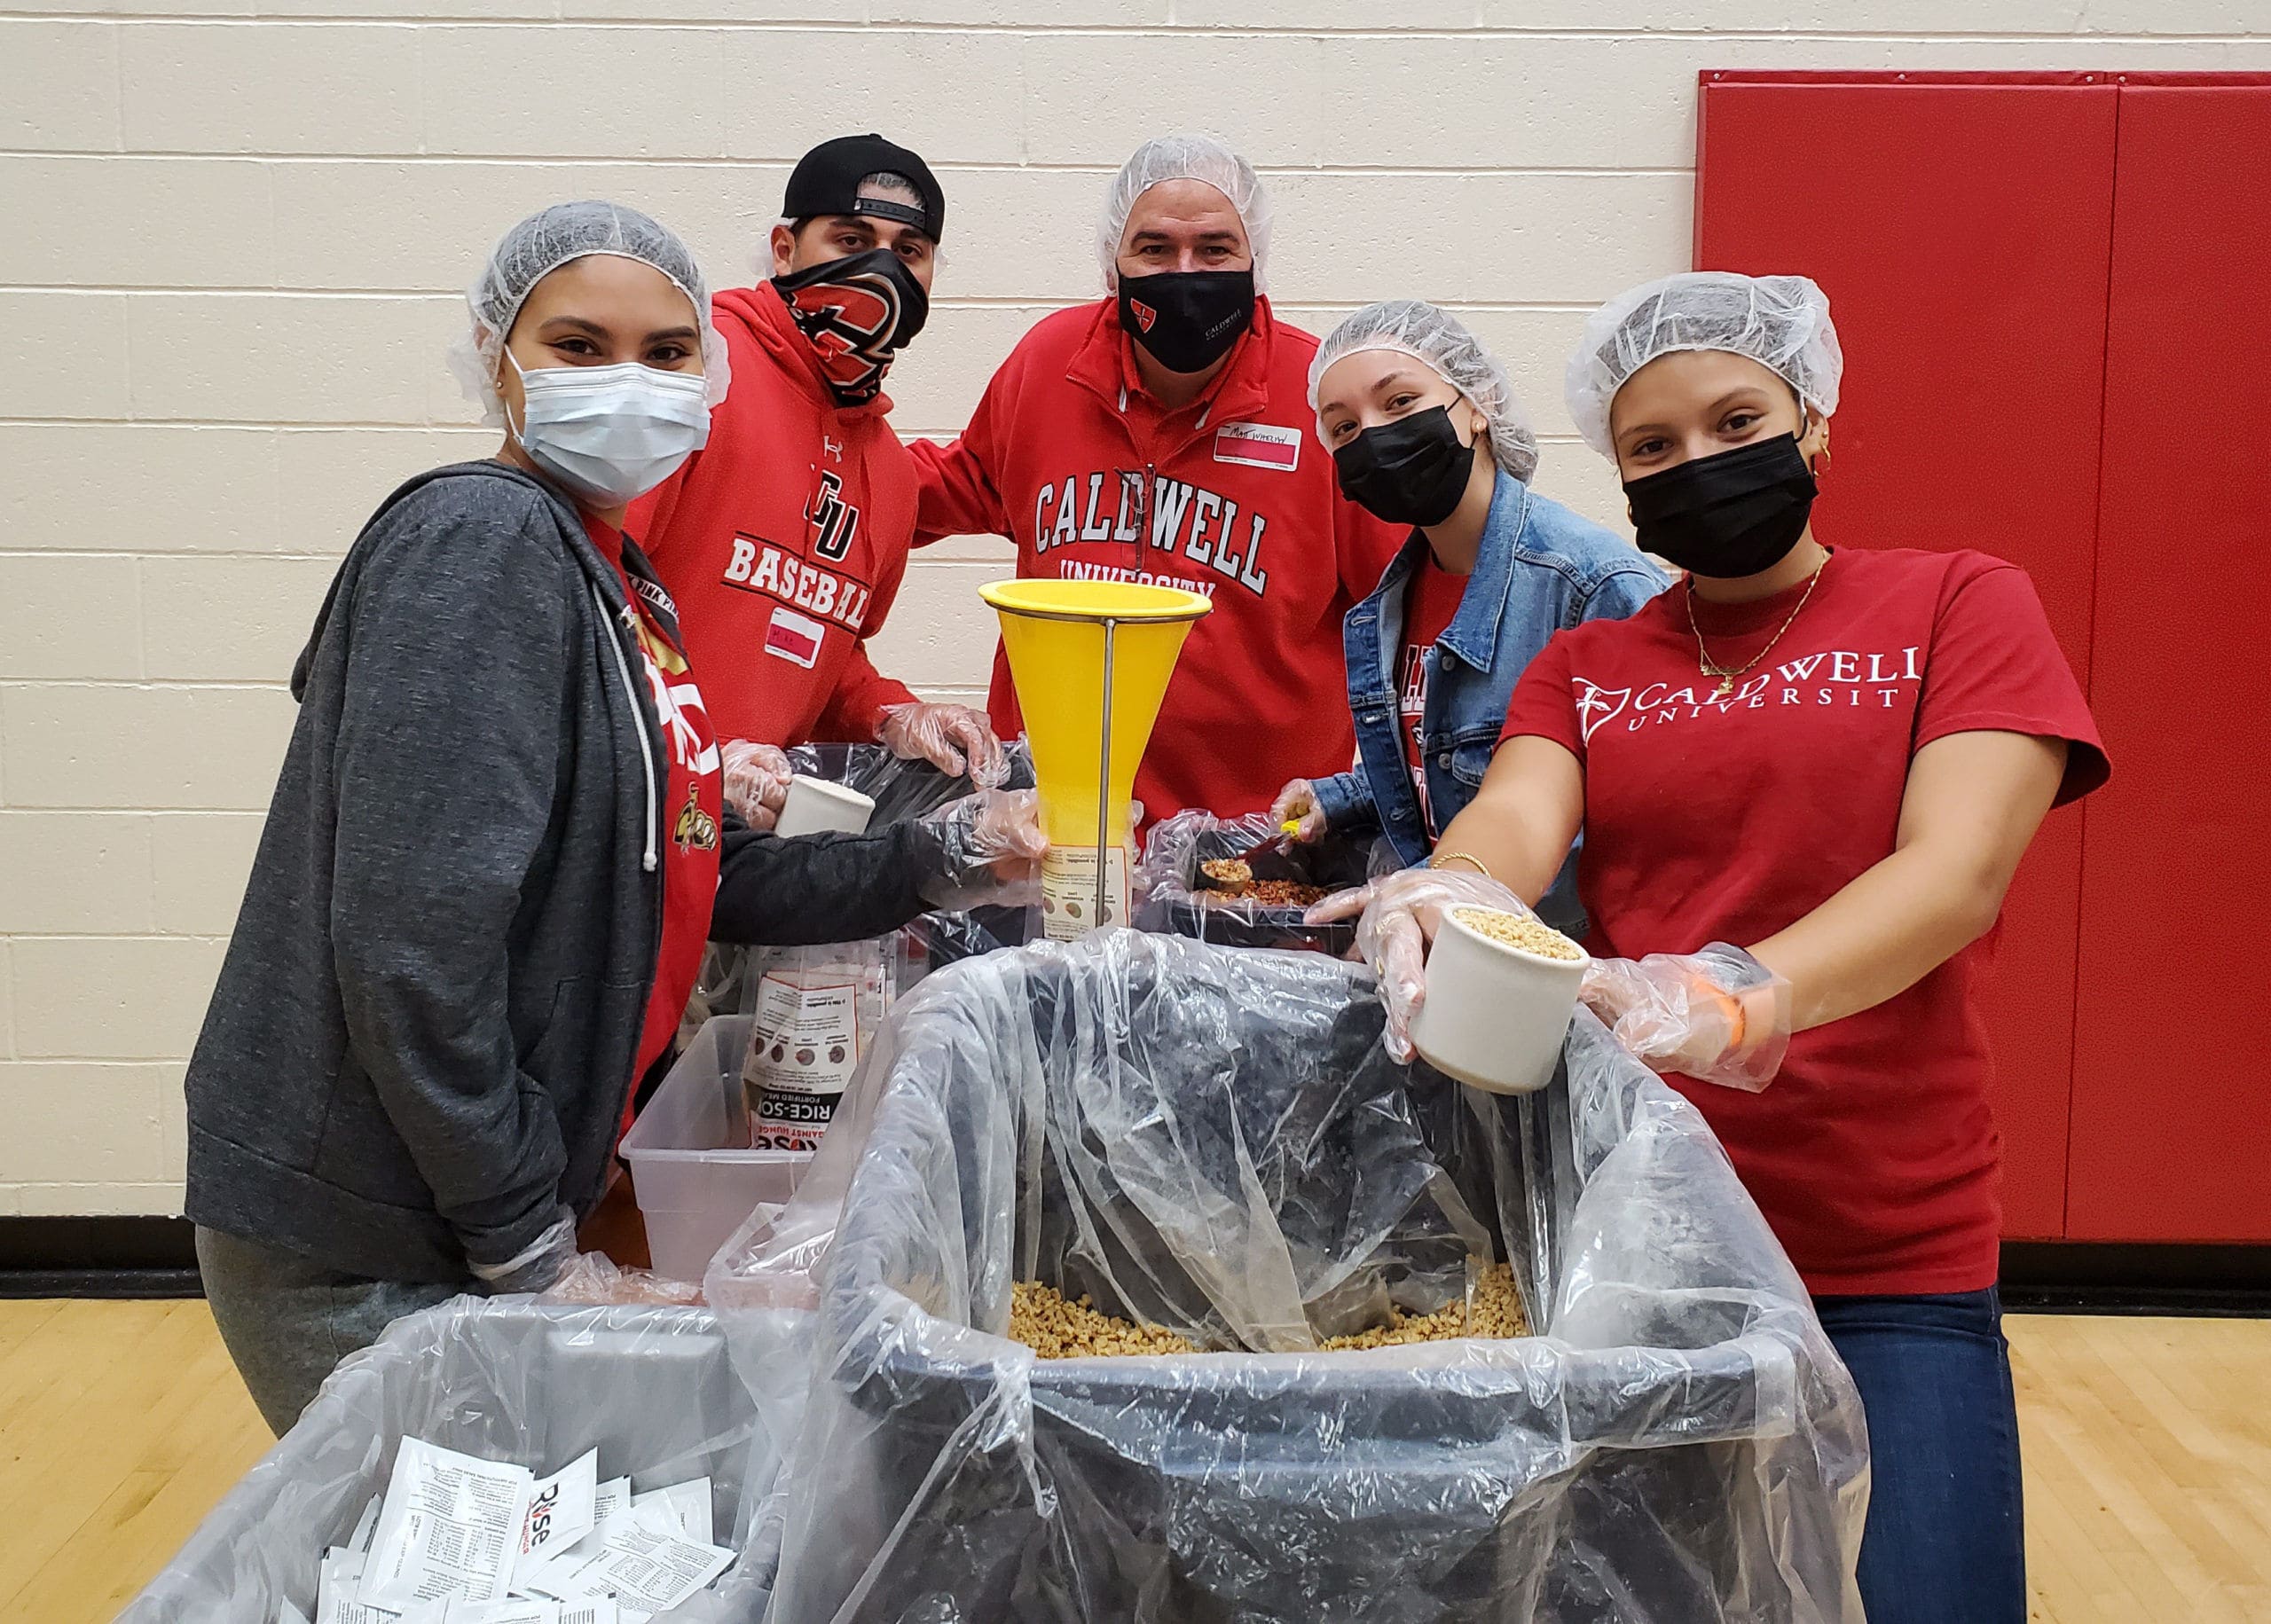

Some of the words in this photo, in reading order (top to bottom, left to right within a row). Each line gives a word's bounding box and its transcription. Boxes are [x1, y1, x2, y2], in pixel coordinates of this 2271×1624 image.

[1035, 473, 1267, 598] CALDWELL
[635, 580, 663, 602] PINK
[724, 537, 868, 629] BASEBAL
[1627, 687, 1918, 732] UNIVERSIT
[782, 1094, 821, 1103] FORTIFIED
[761, 1101, 830, 1120] RICE-SO
[759, 1126, 790, 1135] HUNGE
[791, 1129, 824, 1139] GAINST
